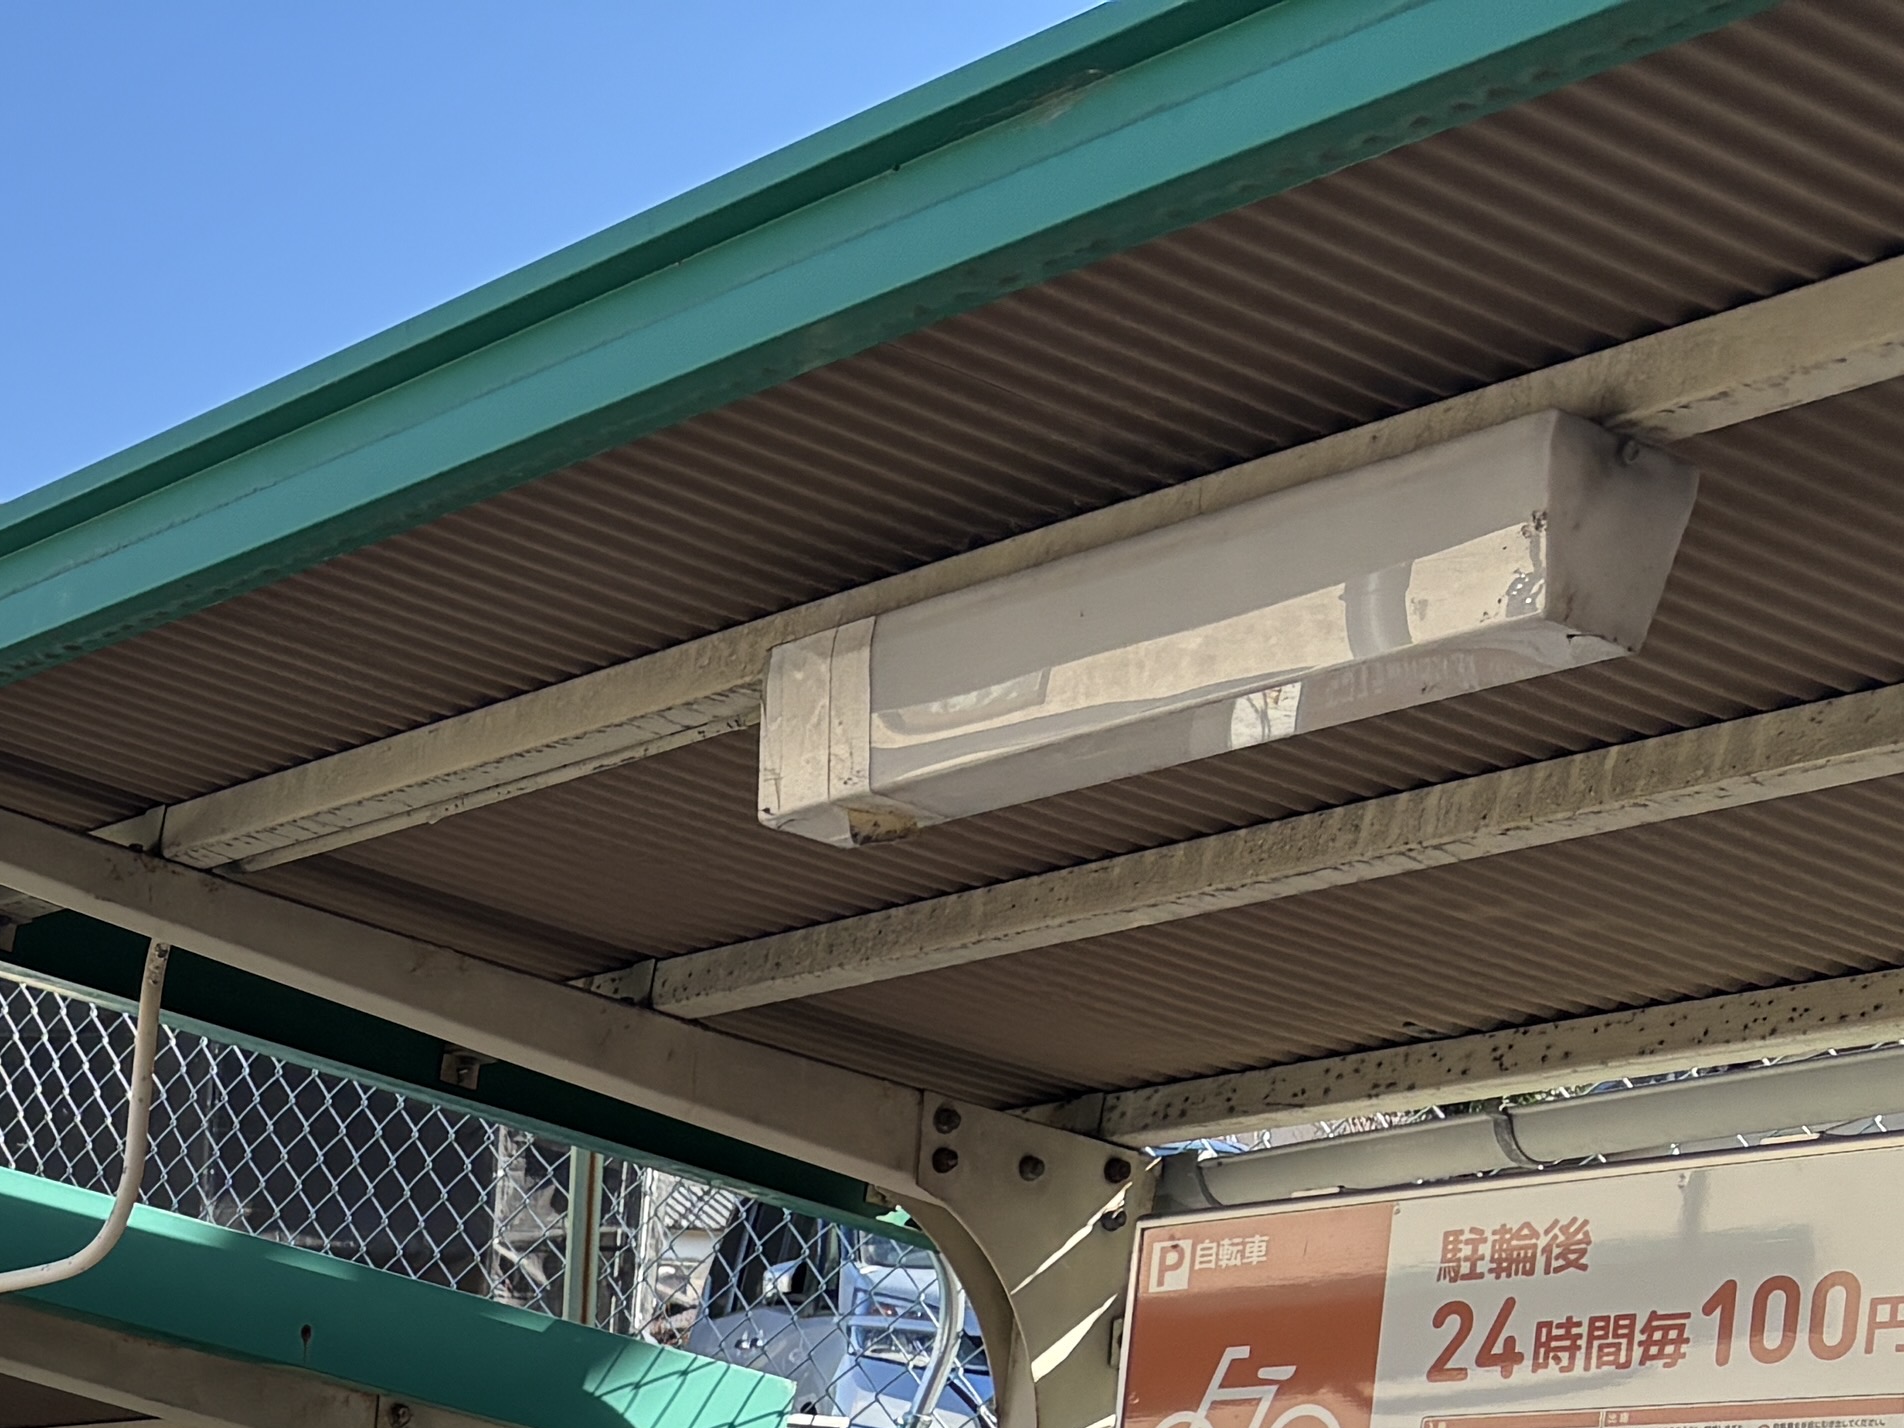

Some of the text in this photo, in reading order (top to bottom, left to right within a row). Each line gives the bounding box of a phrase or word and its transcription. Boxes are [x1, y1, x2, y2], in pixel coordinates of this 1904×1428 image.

[1157, 1235, 1269, 1287] P 自転車
[1436, 1217, 1592, 1283] 駐輪後
